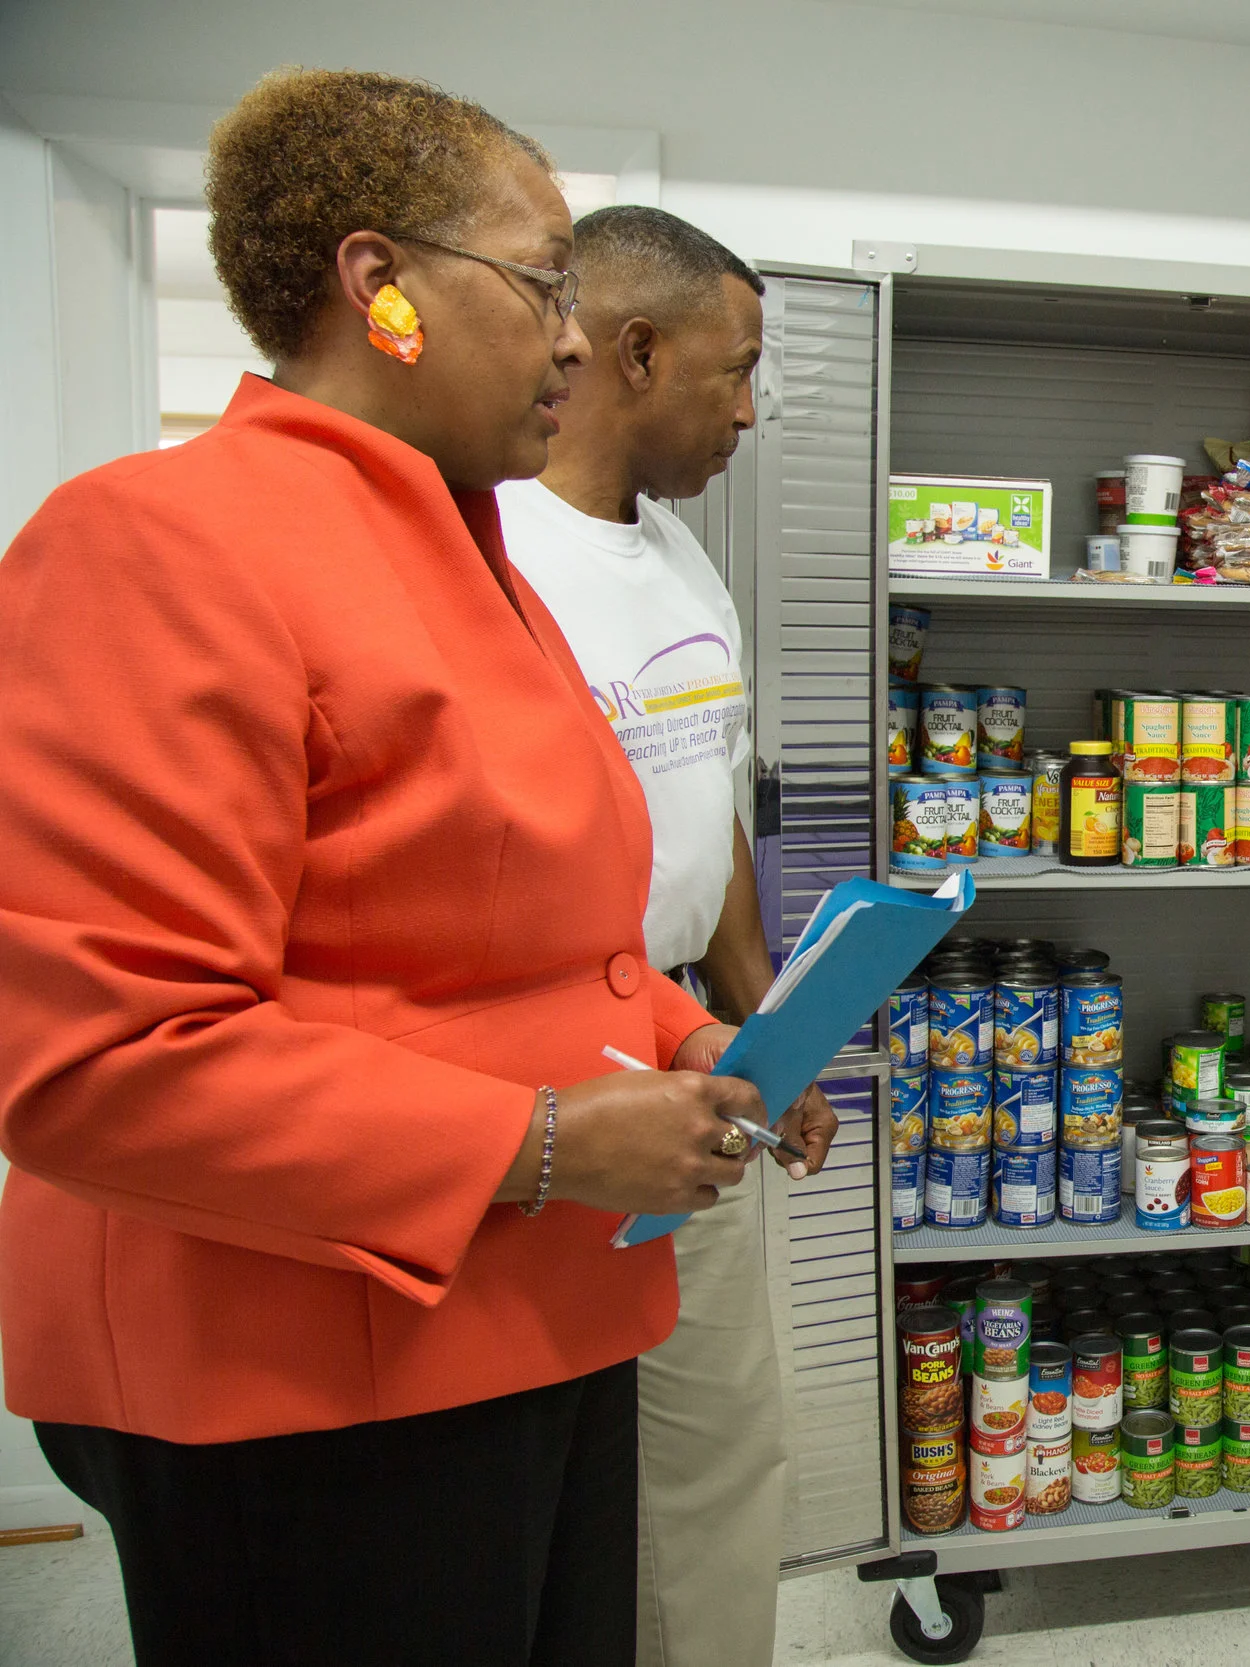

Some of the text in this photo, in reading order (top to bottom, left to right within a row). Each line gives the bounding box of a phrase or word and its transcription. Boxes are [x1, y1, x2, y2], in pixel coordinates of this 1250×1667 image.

[1008, 558, 1033, 569] Giant
[933, 699, 958, 708] PAMPA
[992, 695, 1016, 704] PAMPA
[933, 713, 957, 723] FRUIT
[992, 709, 1014, 719] FRUIT
[616, 720, 665, 743] ommunity
[666, 712, 699, 733] Outreach
[928, 722, 964, 732] COCKTAIL
[985, 718, 1020, 728] COCKTAIL
[1141, 723, 1172, 732] Spaghetti
[1187, 723, 1218, 732] Spaghetti
[1147, 731, 1167, 739] Sauce
[622, 741, 667, 762] eaching
[669, 737, 680, 754] UP
[689, 727, 717, 748] Reach
[1047, 768, 1060, 784] V8
[1096, 779, 1110, 787] SIZE
[998, 784, 1022, 793] PAMPA
[997, 798, 1019, 807] FRUIT
[1033, 797, 1059, 808] ENER
[924, 806, 945, 816] FRUIT
[947, 803, 966, 813] RUIT
[990, 806, 1026, 816] COCKTAIL
[1081, 1000, 1119, 1012] PROGRESSO
[1086, 1013, 1117, 1025] Traditional
[941, 1084, 981, 1096] PROGRESSO
[1072, 1081, 1112, 1092] PROGRESSO
[944, 1096, 977, 1107] Traditional
[1075, 1094, 1108, 1104] Traditional
[1144, 1176, 1175, 1185] Cranberry
[991, 1308, 1015, 1317] HEINZ
[983, 1319, 1022, 1330] VEGETARIAN
[984, 1327, 1021, 1338] BEANS
[920, 1360, 946, 1370] PORK
[1077, 1356, 1100, 1366] Essential
[911, 1365, 955, 1383] BEANS
[1041, 1366, 1065, 1376] Essential
[981, 1394, 993, 1403] Pork
[1038, 1417, 1053, 1425] Light
[1091, 1432, 1114, 1441] Essential
[913, 1443, 954, 1459] BUSH'S
[911, 1466, 956, 1481] Original
[1030, 1466, 1066, 1477] Blackeye
